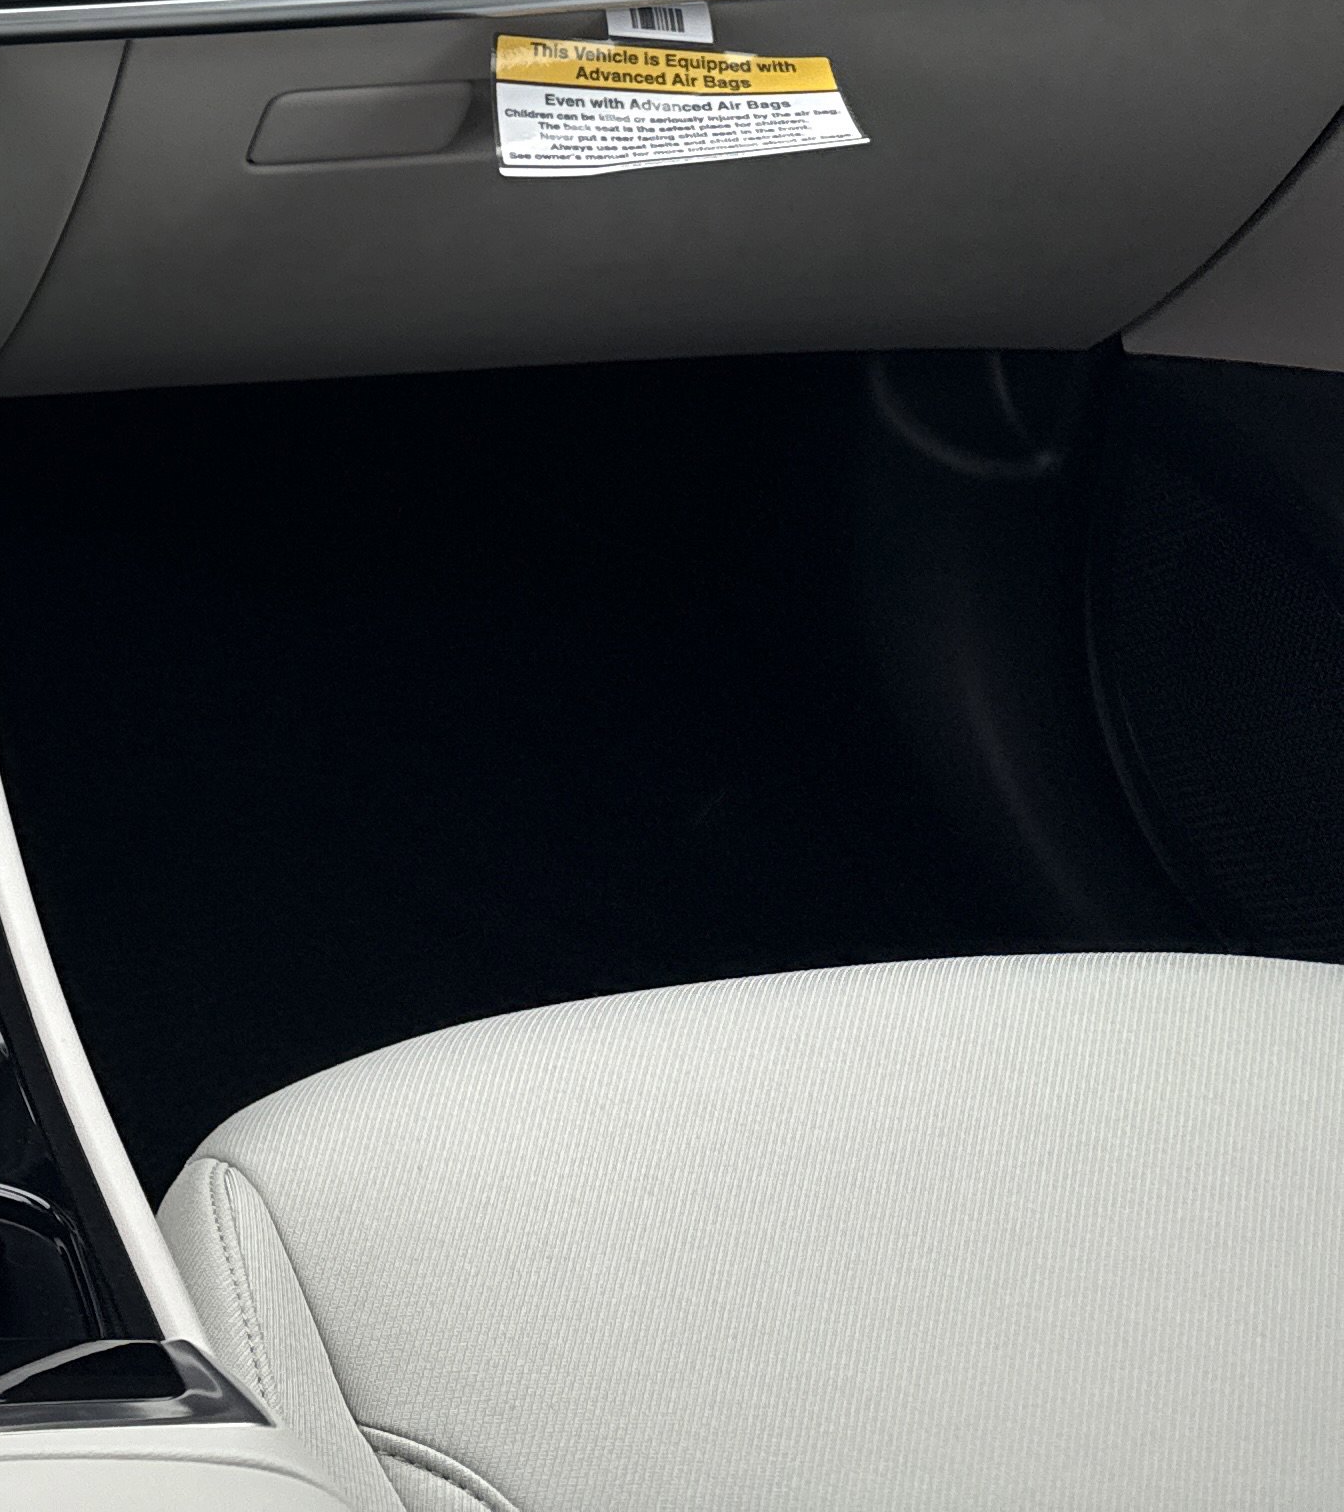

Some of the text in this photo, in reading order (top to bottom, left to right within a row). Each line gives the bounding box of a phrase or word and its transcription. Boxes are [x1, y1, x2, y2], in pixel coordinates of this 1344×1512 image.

[530, 41, 797, 74] This Vehicle is Equipped with
[576, 66, 752, 91] Advanced Air Bags
[545, 93, 791, 112] Even with Advanced Air Bags
[505, 108, 553, 119] Children
[538, 121, 560, 130] The
